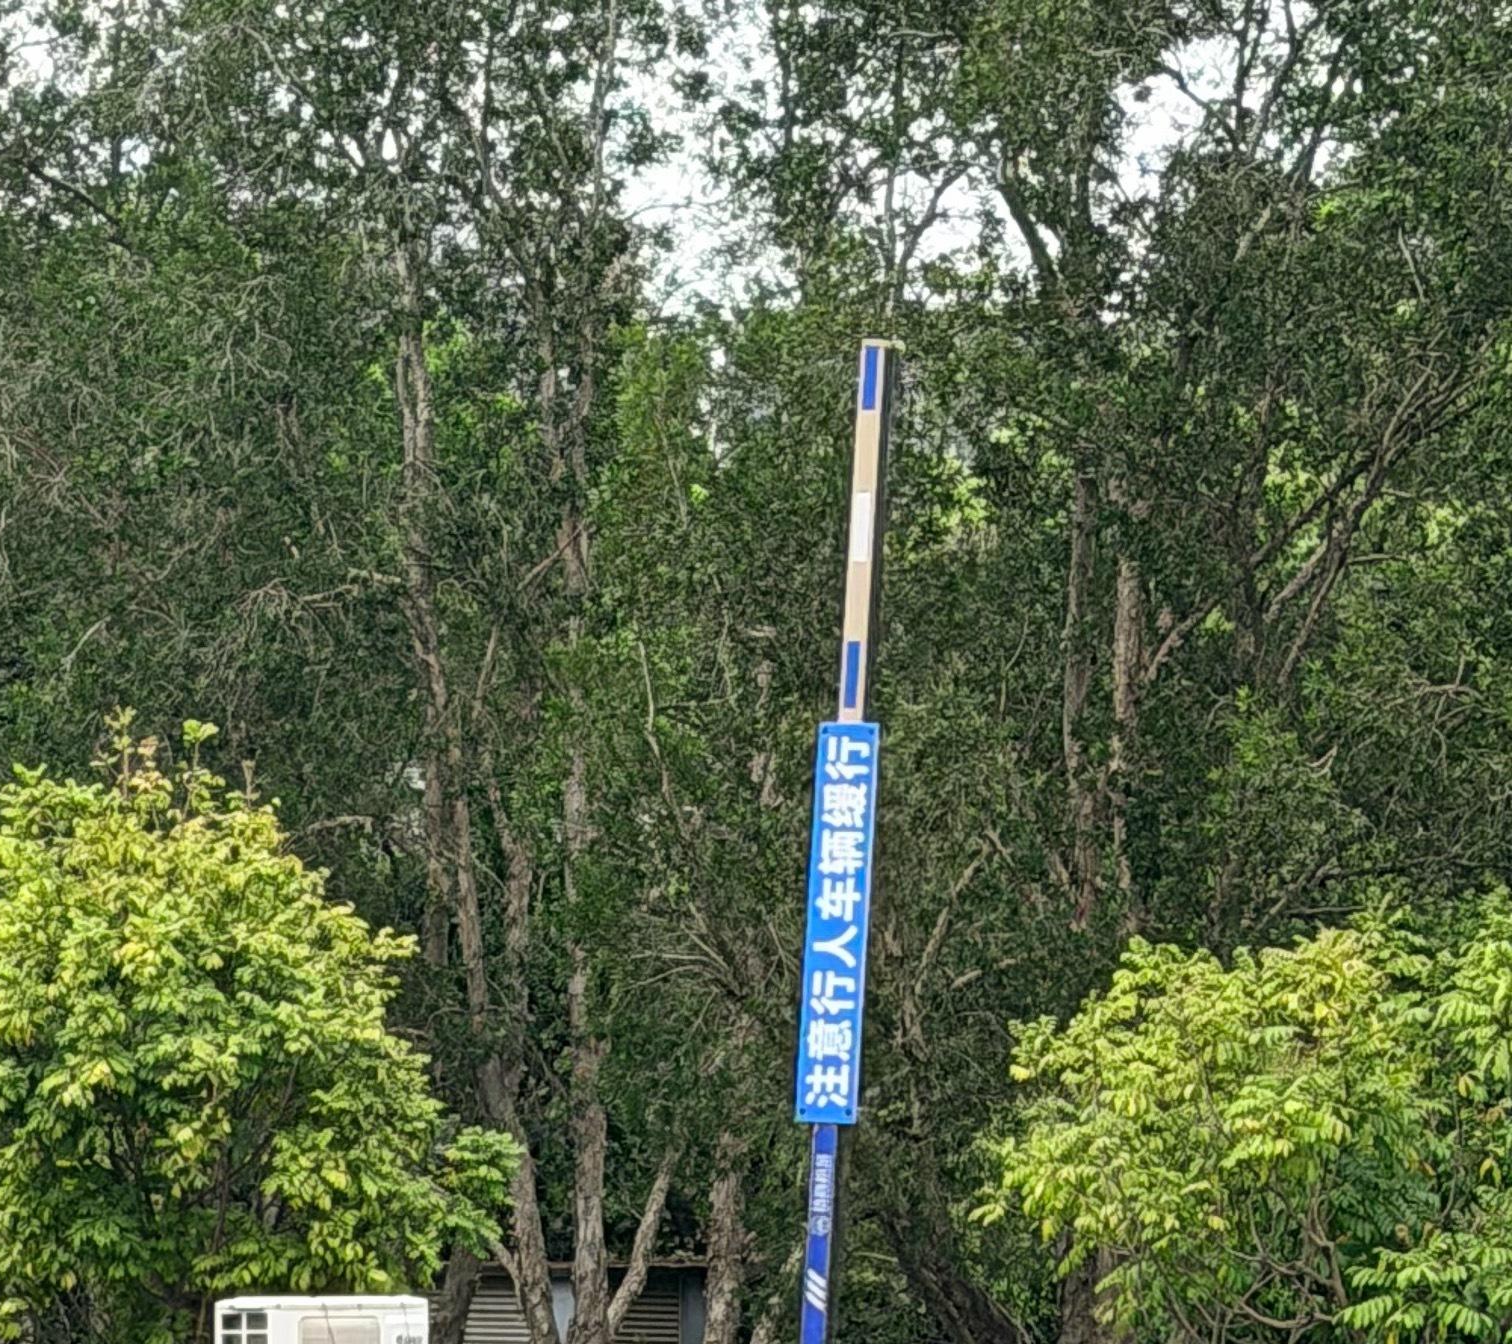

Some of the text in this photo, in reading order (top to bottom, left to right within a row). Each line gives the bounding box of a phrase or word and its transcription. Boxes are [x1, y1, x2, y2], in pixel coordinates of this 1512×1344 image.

[803, 733, 872, 1110] 注意行人车辆缓行
